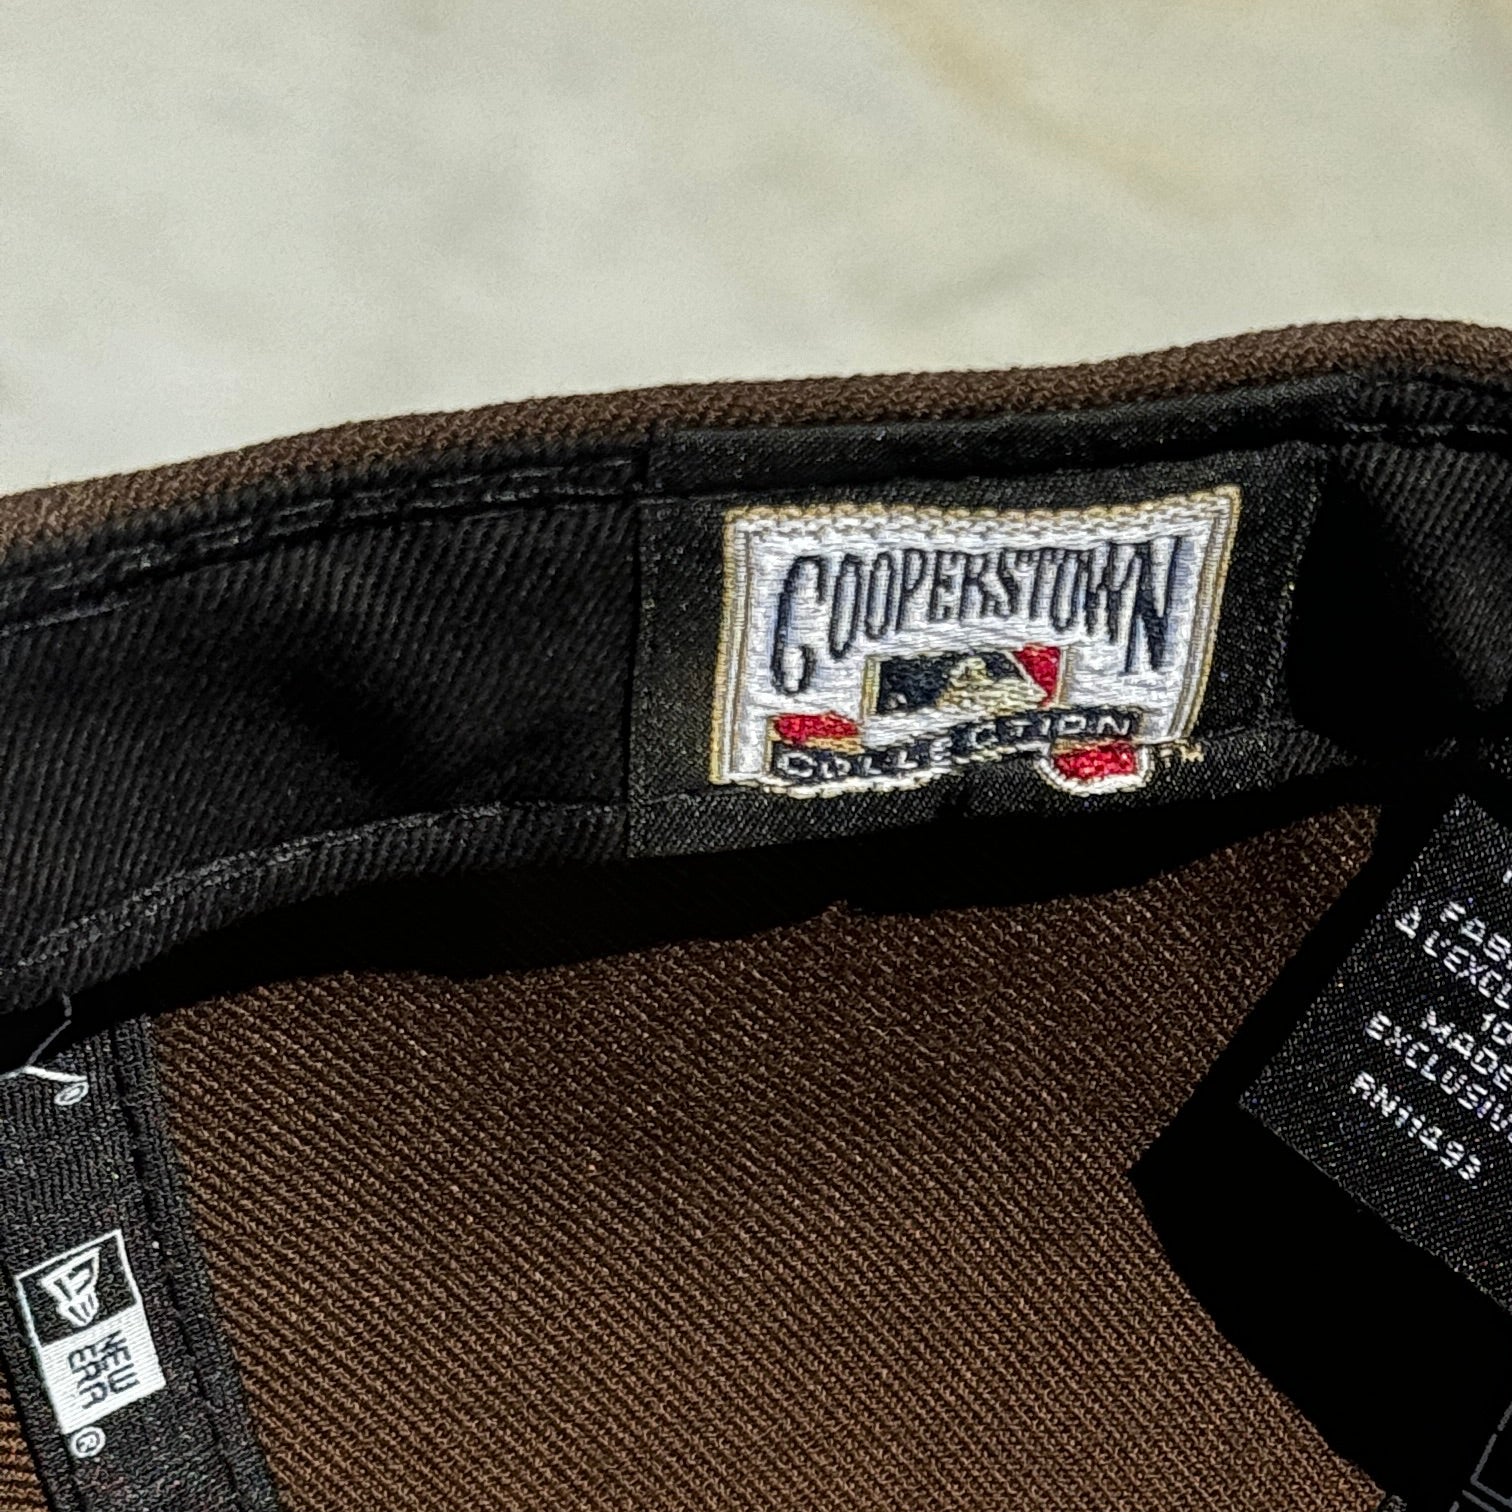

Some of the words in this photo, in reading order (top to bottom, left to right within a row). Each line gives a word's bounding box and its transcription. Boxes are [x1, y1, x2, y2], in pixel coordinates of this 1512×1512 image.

[771, 536, 1182, 694] COOPERSTOWN
[775, 712, 1132, 779] COLLECTION
[68, 1343, 108, 1410] ERA
[99, 1329, 141, 1397] NEW
